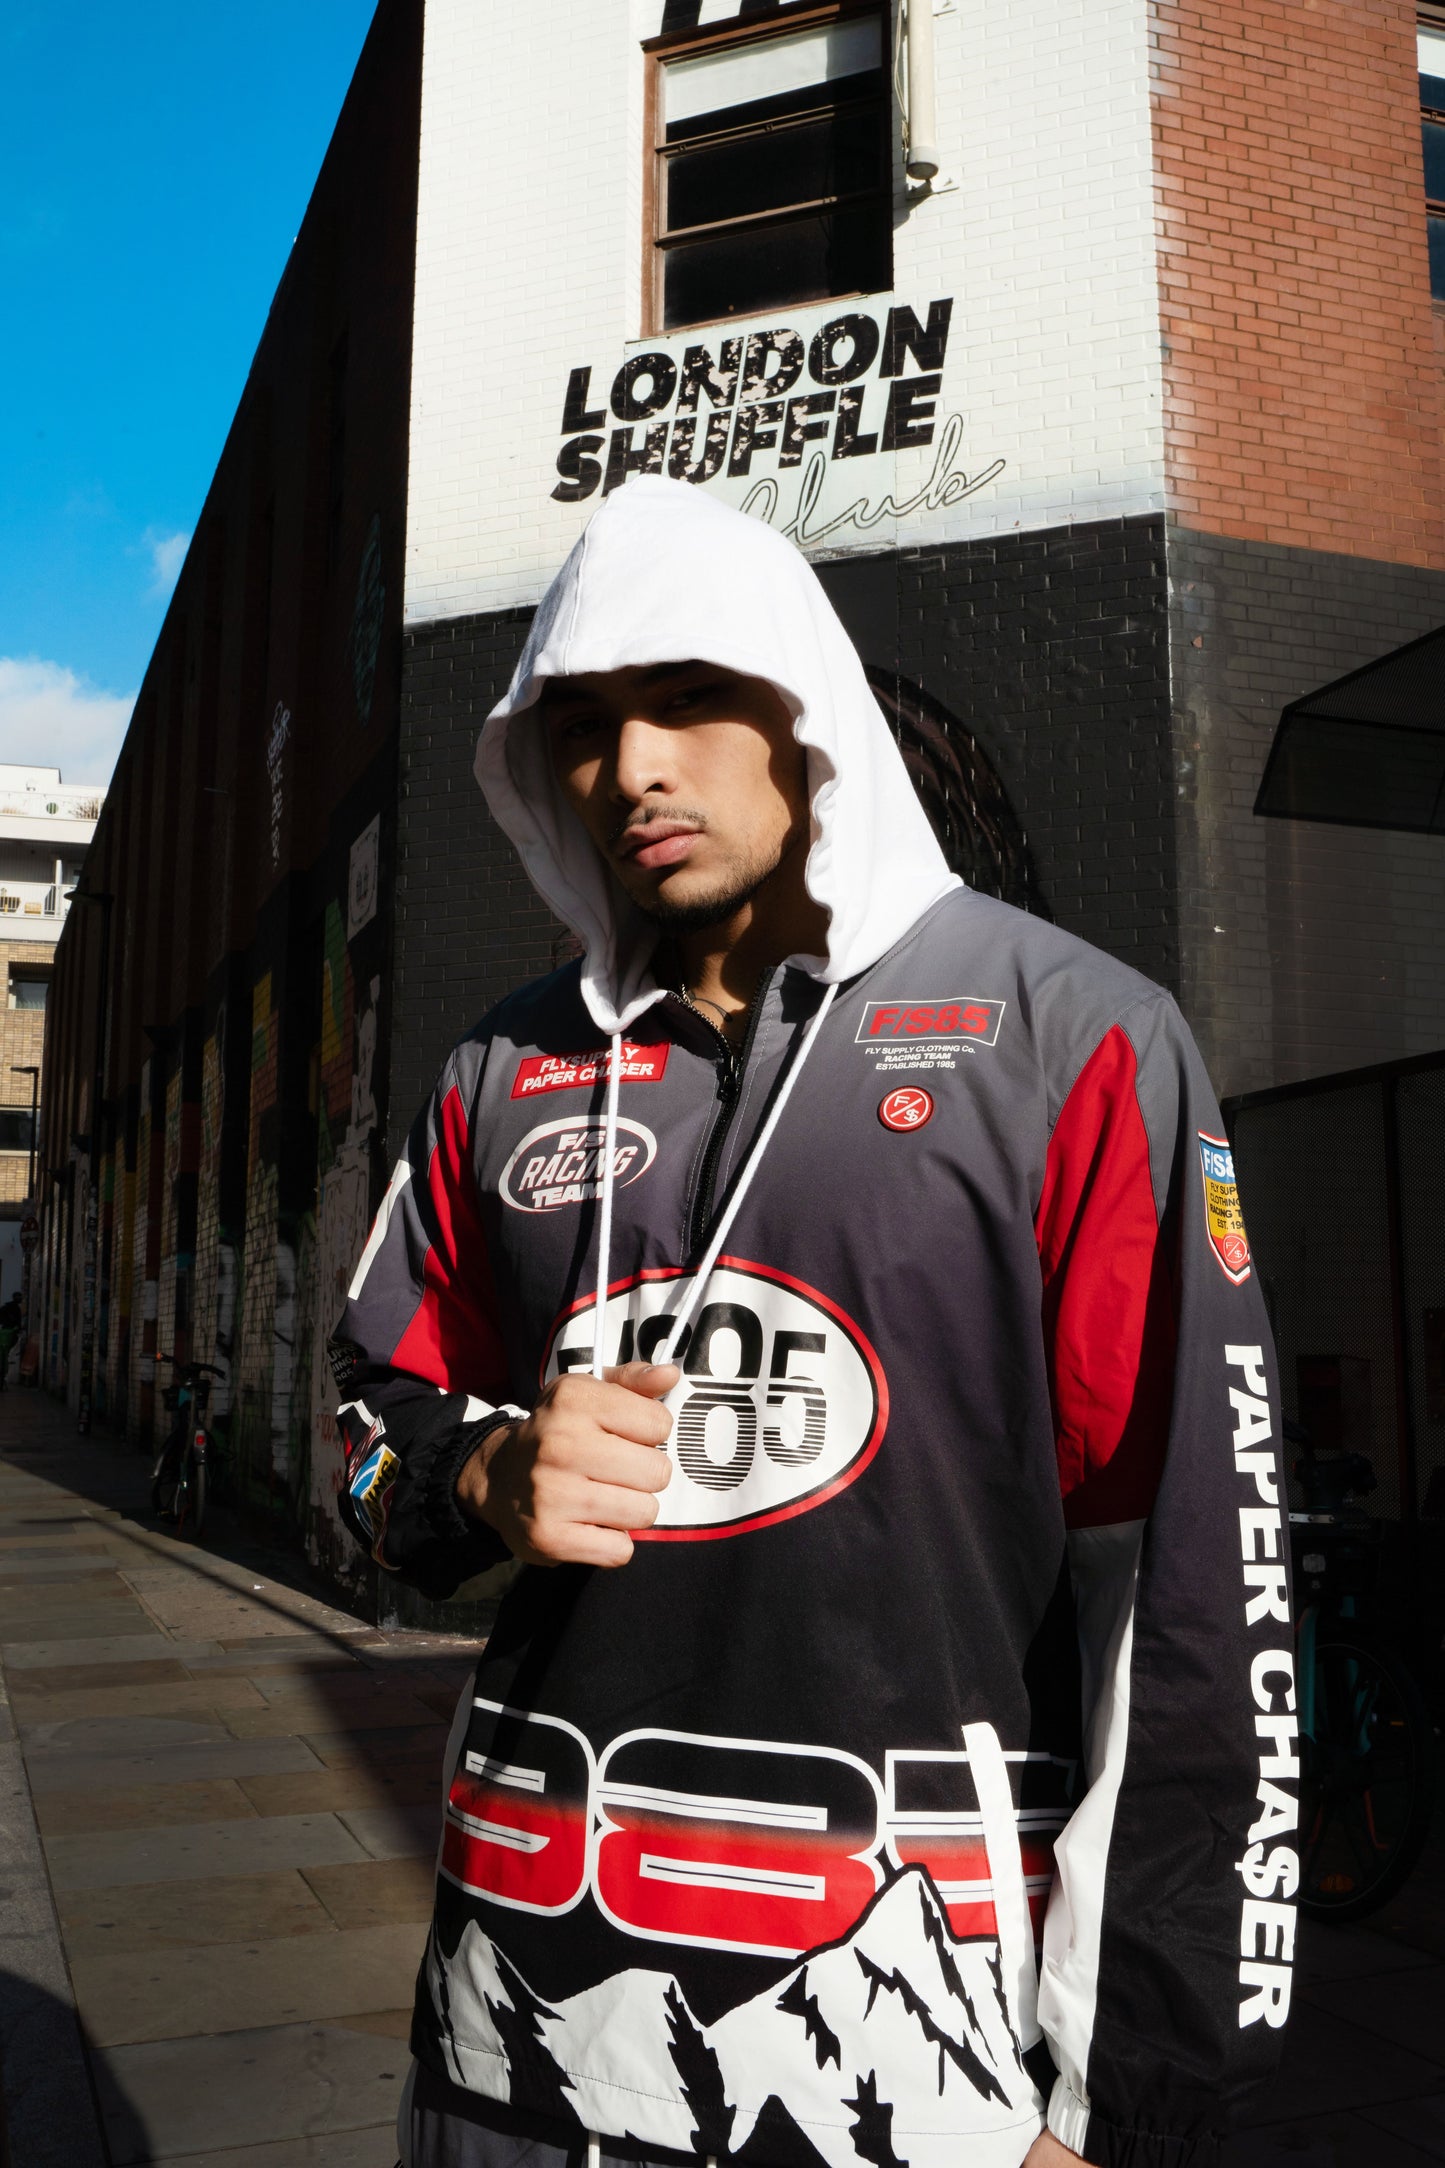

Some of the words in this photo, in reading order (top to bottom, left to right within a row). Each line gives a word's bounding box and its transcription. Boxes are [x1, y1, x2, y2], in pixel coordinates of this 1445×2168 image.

[561, 297, 954, 435] LONDON
[550, 373, 943, 503] SHUFFLE
[868, 1004, 991, 1036] F/S85
[865, 1047, 881, 1055] FLY
[881, 1046, 915, 1055] SUPPLY
[915, 1045, 960, 1053] CLOTHING
[875, 1060, 934, 1070] ESTABLISHED
[936, 1060, 956, 1069] 1985
[884, 1053, 921, 1063] RACING
[923, 1052, 952, 1060] TEAM
[521, 1070, 578, 1093] PAPER
[517, 1145, 639, 1192] RACING
[531, 1181, 604, 1210] TEAM
[1225, 1344, 1291, 1627] PAPER
